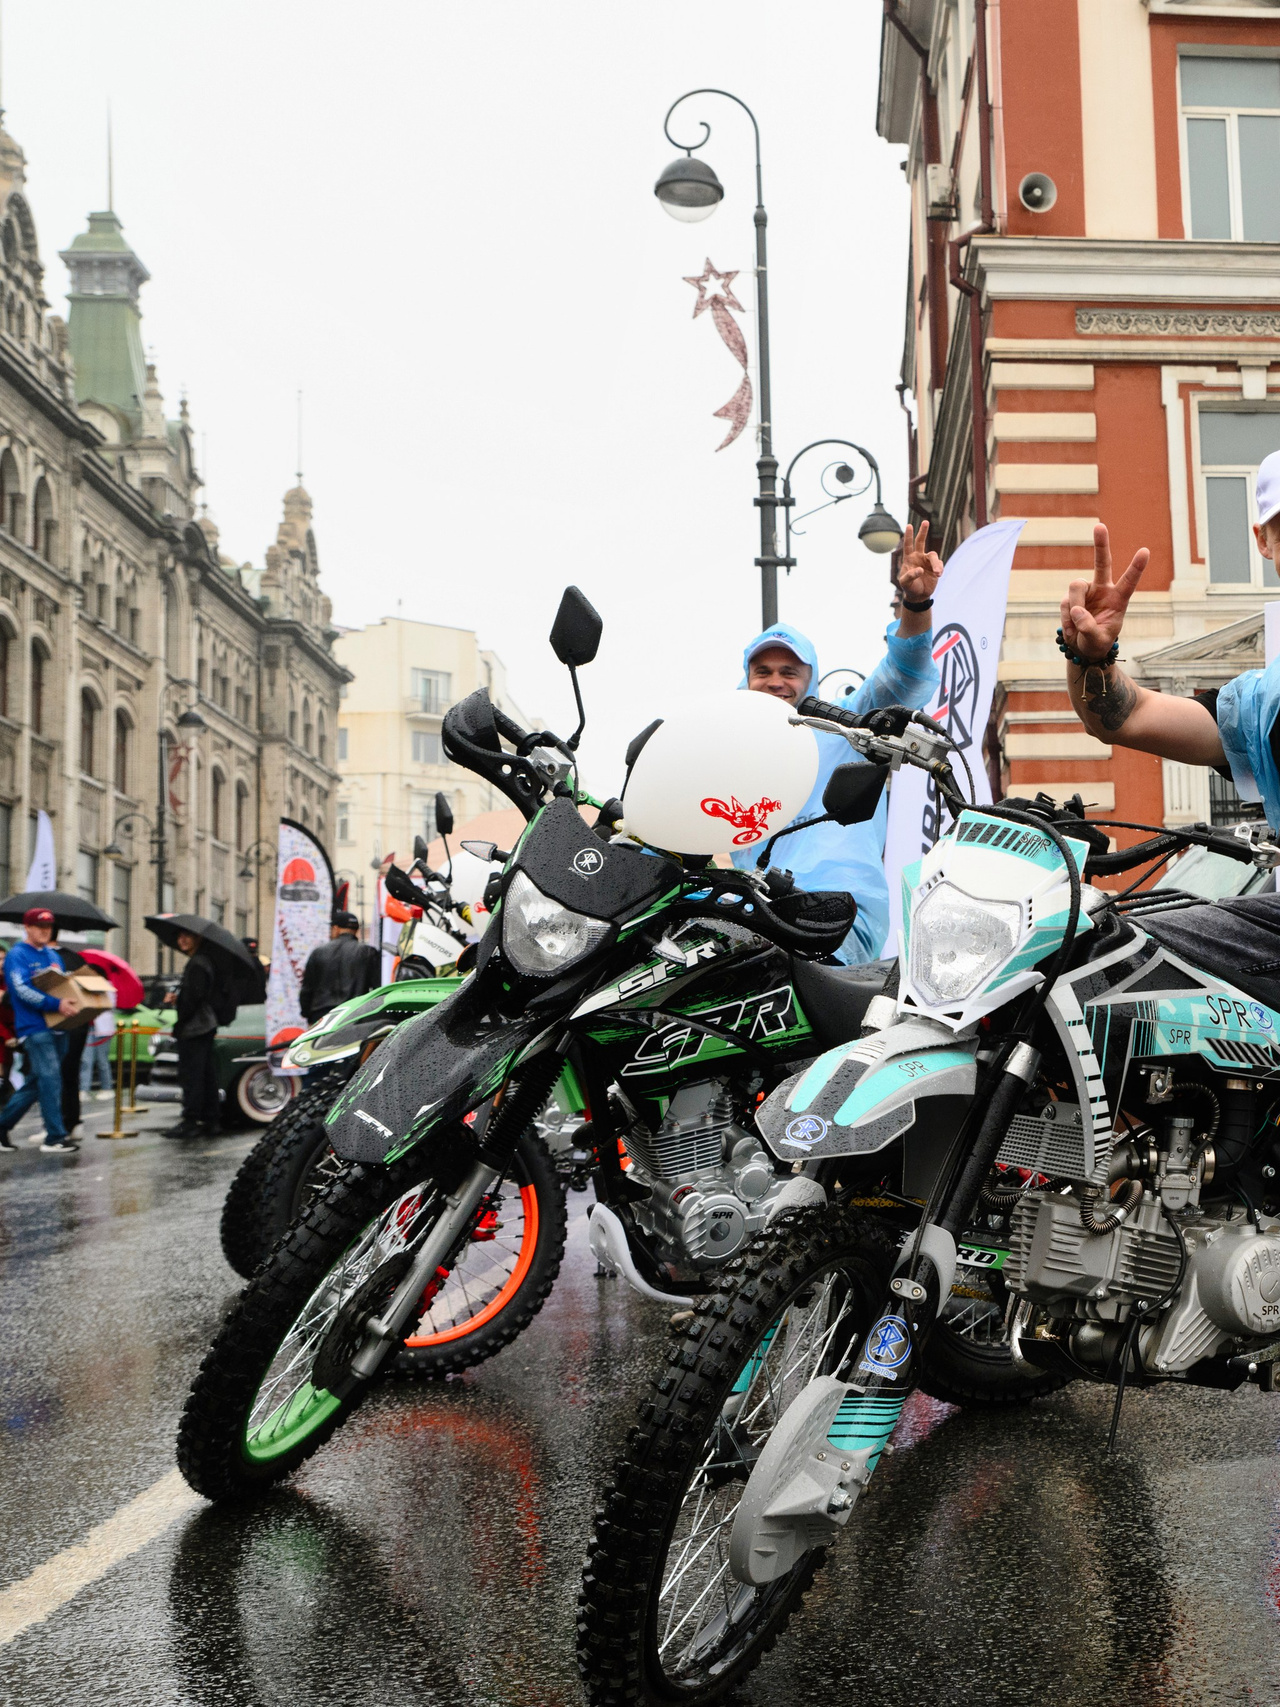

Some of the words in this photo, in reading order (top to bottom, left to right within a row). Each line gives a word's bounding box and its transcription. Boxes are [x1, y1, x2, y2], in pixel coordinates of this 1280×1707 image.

[1206, 995, 1253, 1029] SPR
[1169, 1028, 1191, 1046] SPR
[898, 1060, 930, 1078] SPR
[353, 1109, 394, 1138] SPR
[711, 1211, 734, 1220] SPR
[1262, 1305, 1280, 1316] SPR
